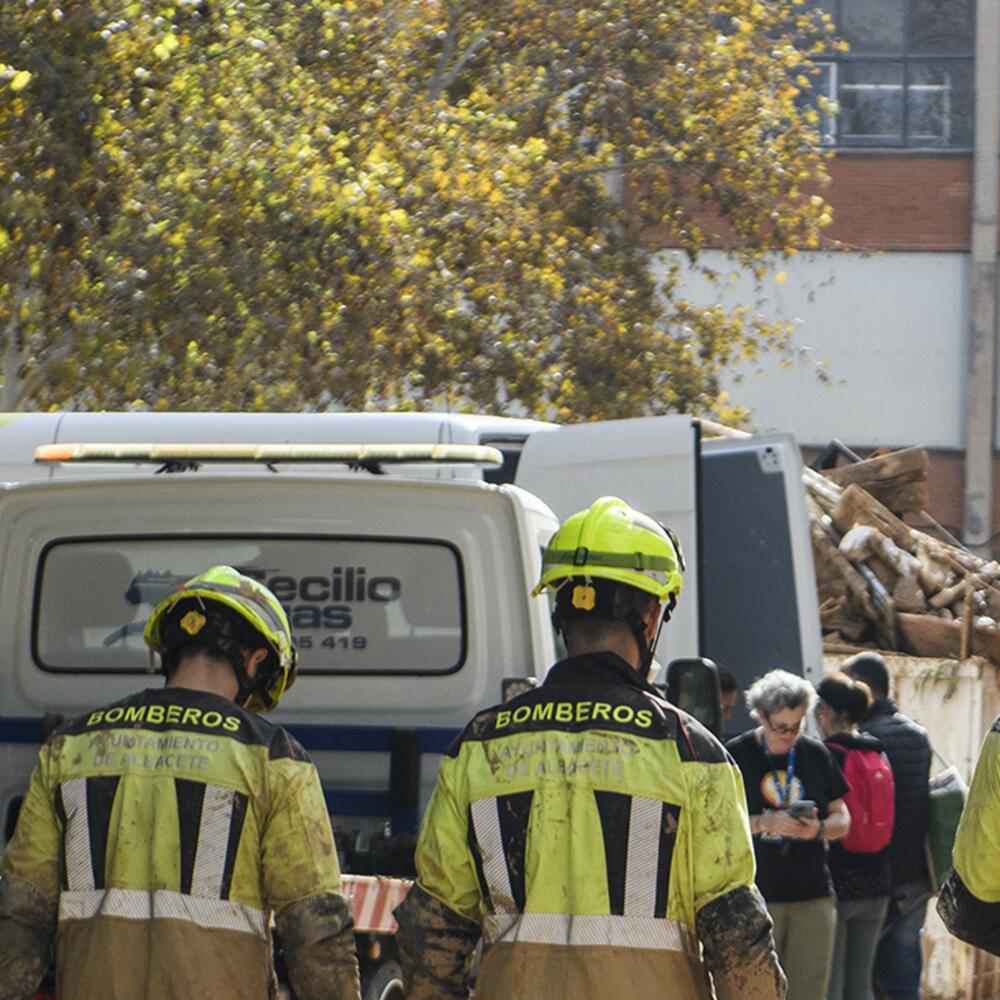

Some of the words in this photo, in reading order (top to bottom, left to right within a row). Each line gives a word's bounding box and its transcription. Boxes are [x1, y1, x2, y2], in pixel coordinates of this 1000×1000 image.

[86, 704, 241, 732] BOMBEROS
[495, 702, 653, 729] BOMBEROS
[88, 733, 221, 753] AYUNTAMIENTO
